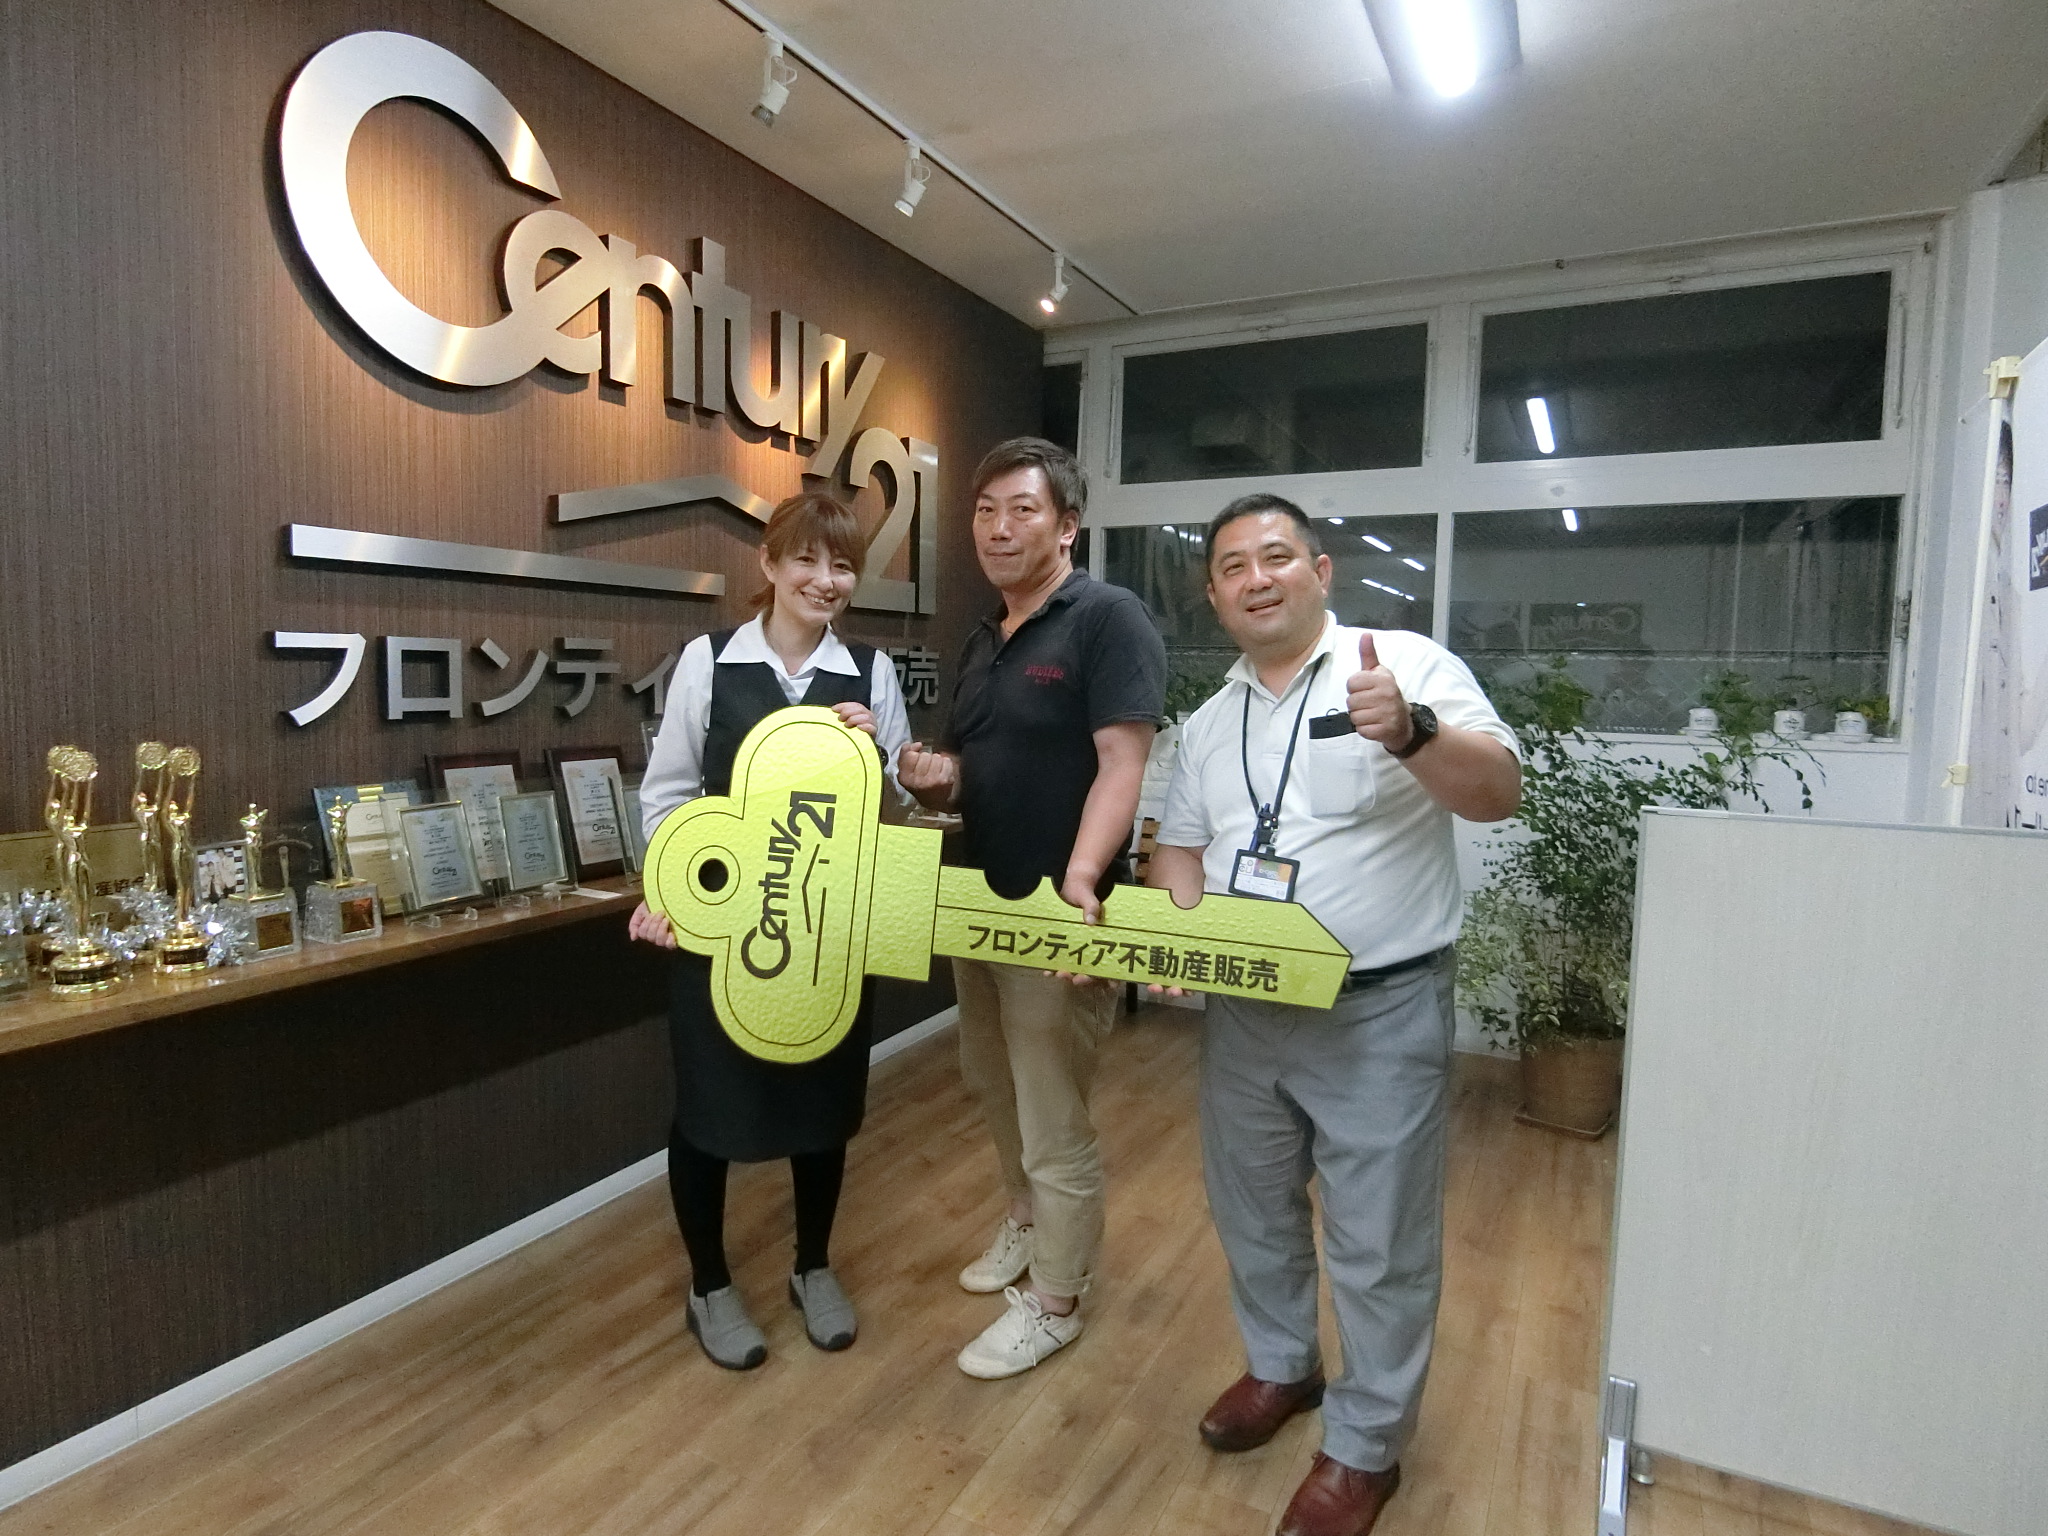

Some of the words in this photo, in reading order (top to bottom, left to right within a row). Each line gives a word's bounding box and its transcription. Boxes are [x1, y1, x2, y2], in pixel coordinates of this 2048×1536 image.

[281, 30, 885, 478] Century
[849, 427, 939, 614] 21
[741, 817, 801, 980] Century
[787, 791, 838, 839] 21
[967, 924, 1280, 993] フロンティア不動産販売
